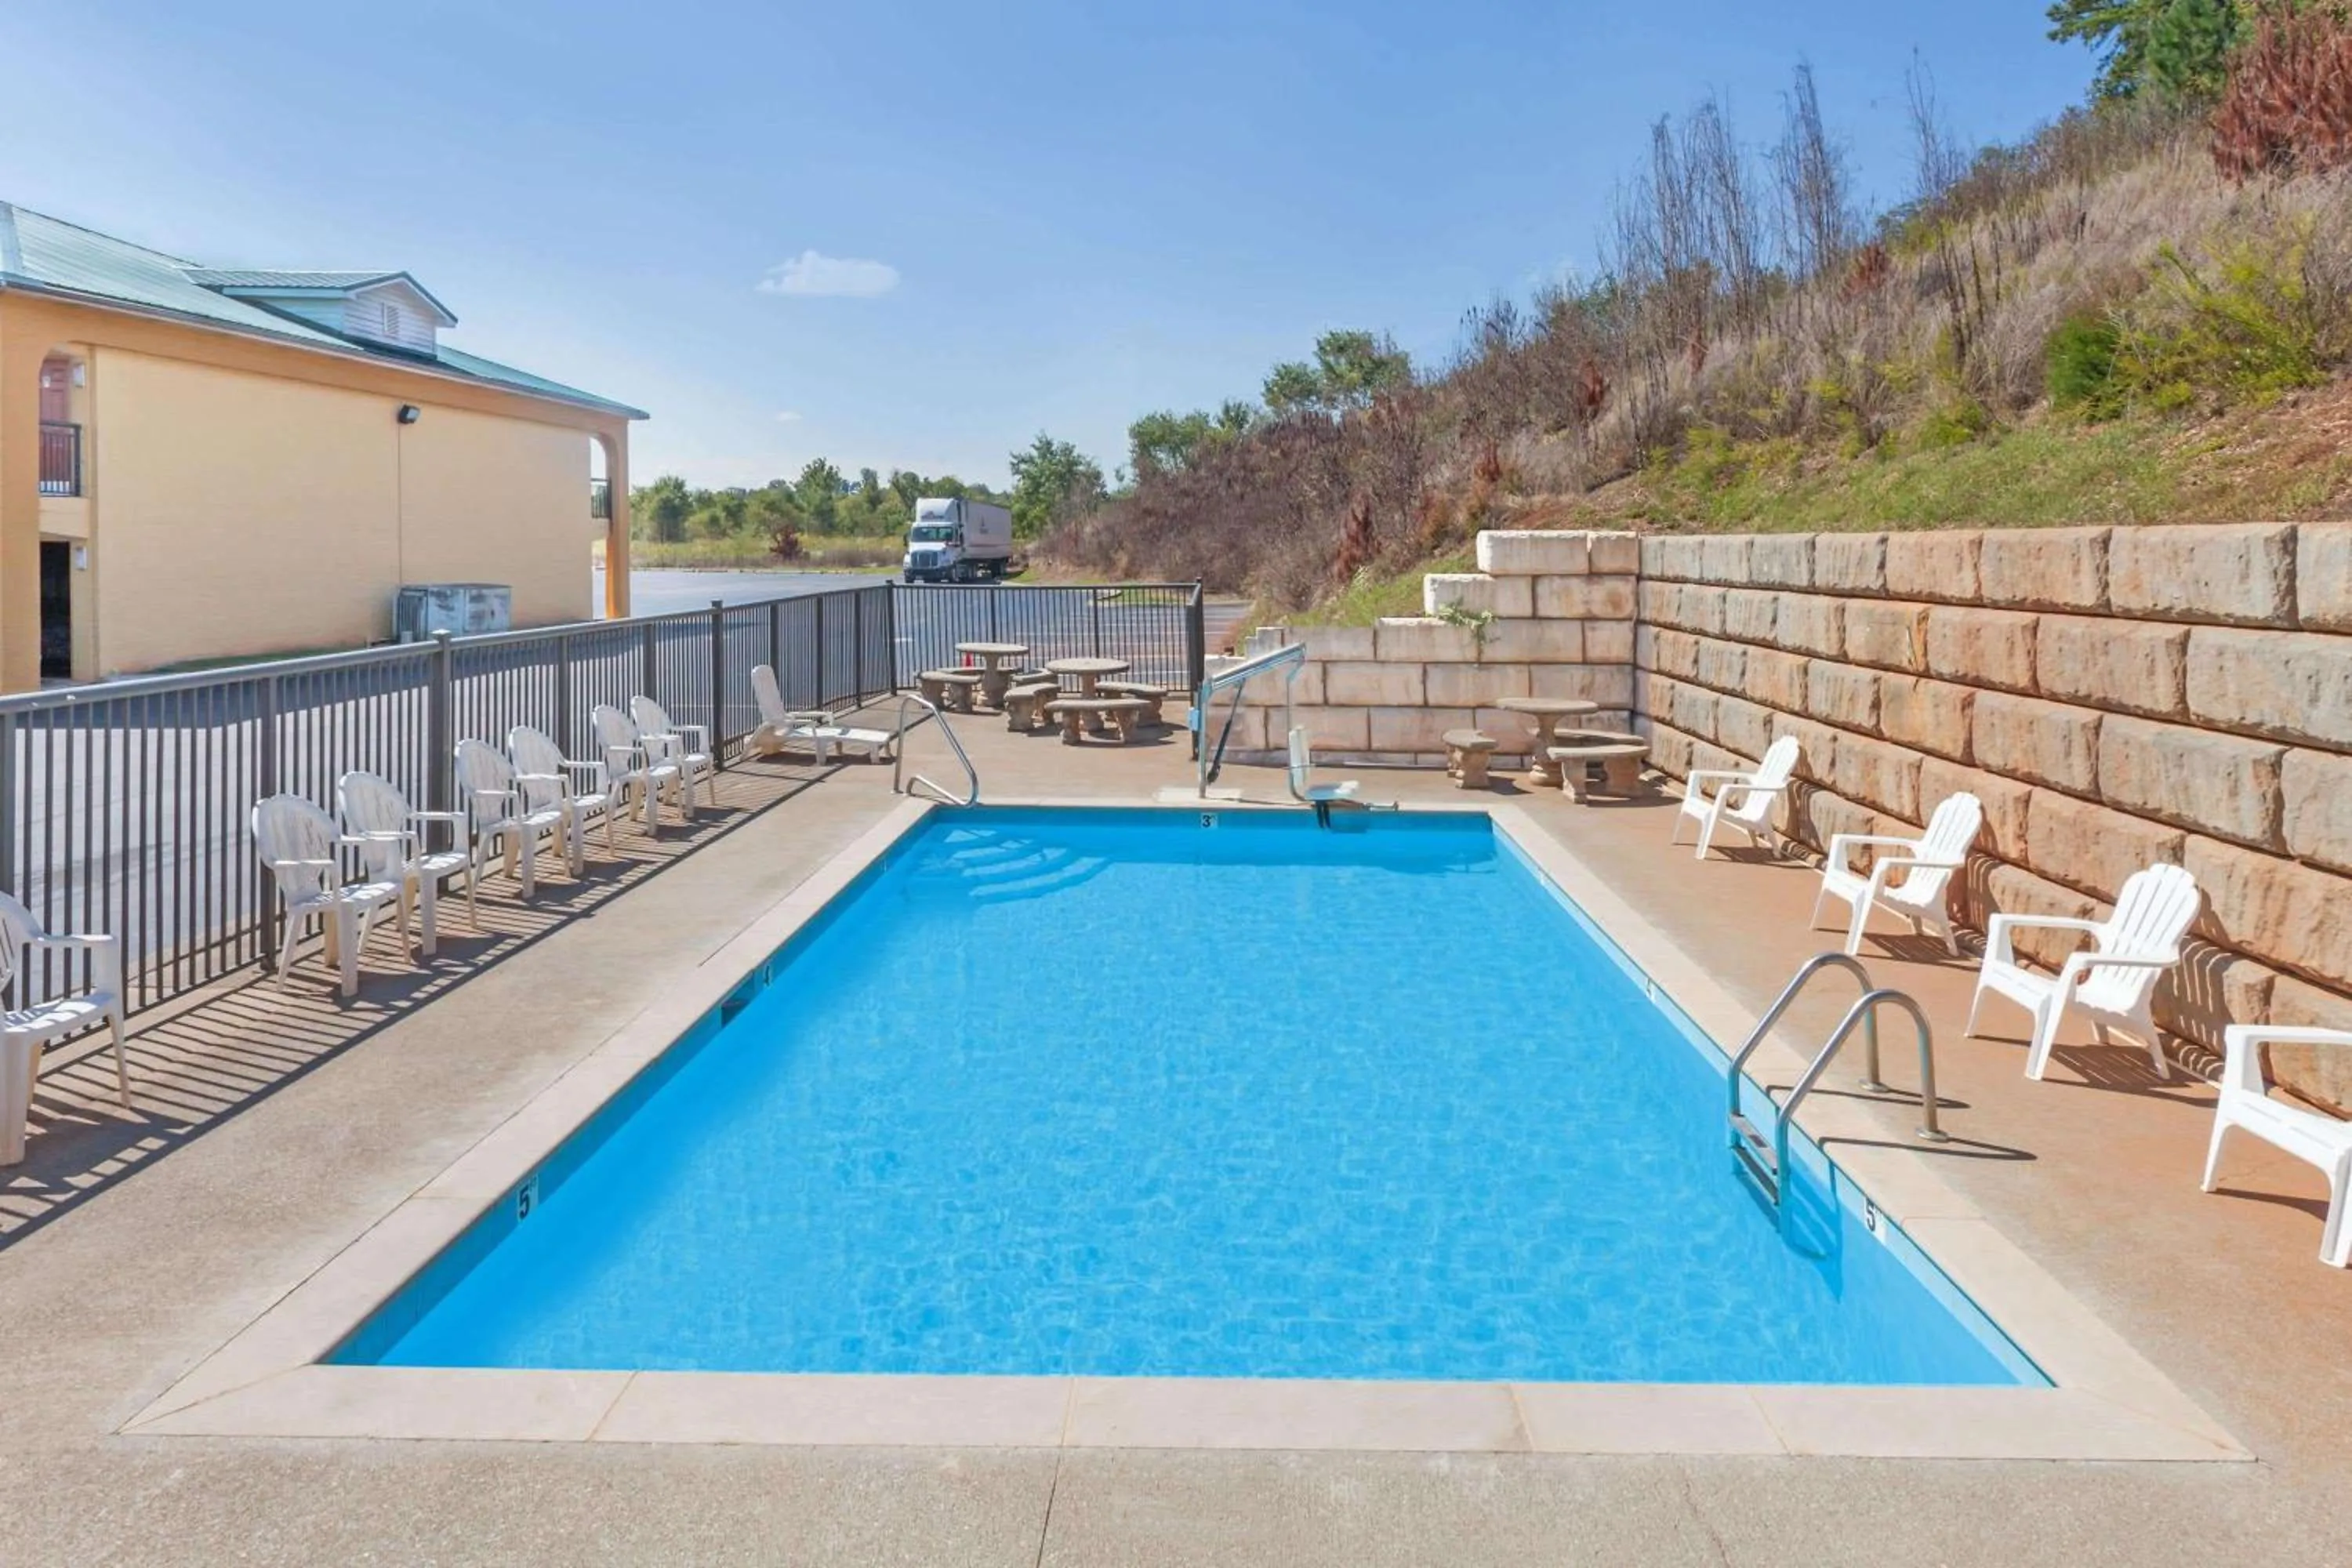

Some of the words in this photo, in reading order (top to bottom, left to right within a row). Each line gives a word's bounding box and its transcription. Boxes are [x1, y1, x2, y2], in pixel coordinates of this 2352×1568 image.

[1202, 815, 1211, 828] 3
[519, 1184, 530, 1220] 5
[1866, 1197, 1876, 1232] 5
